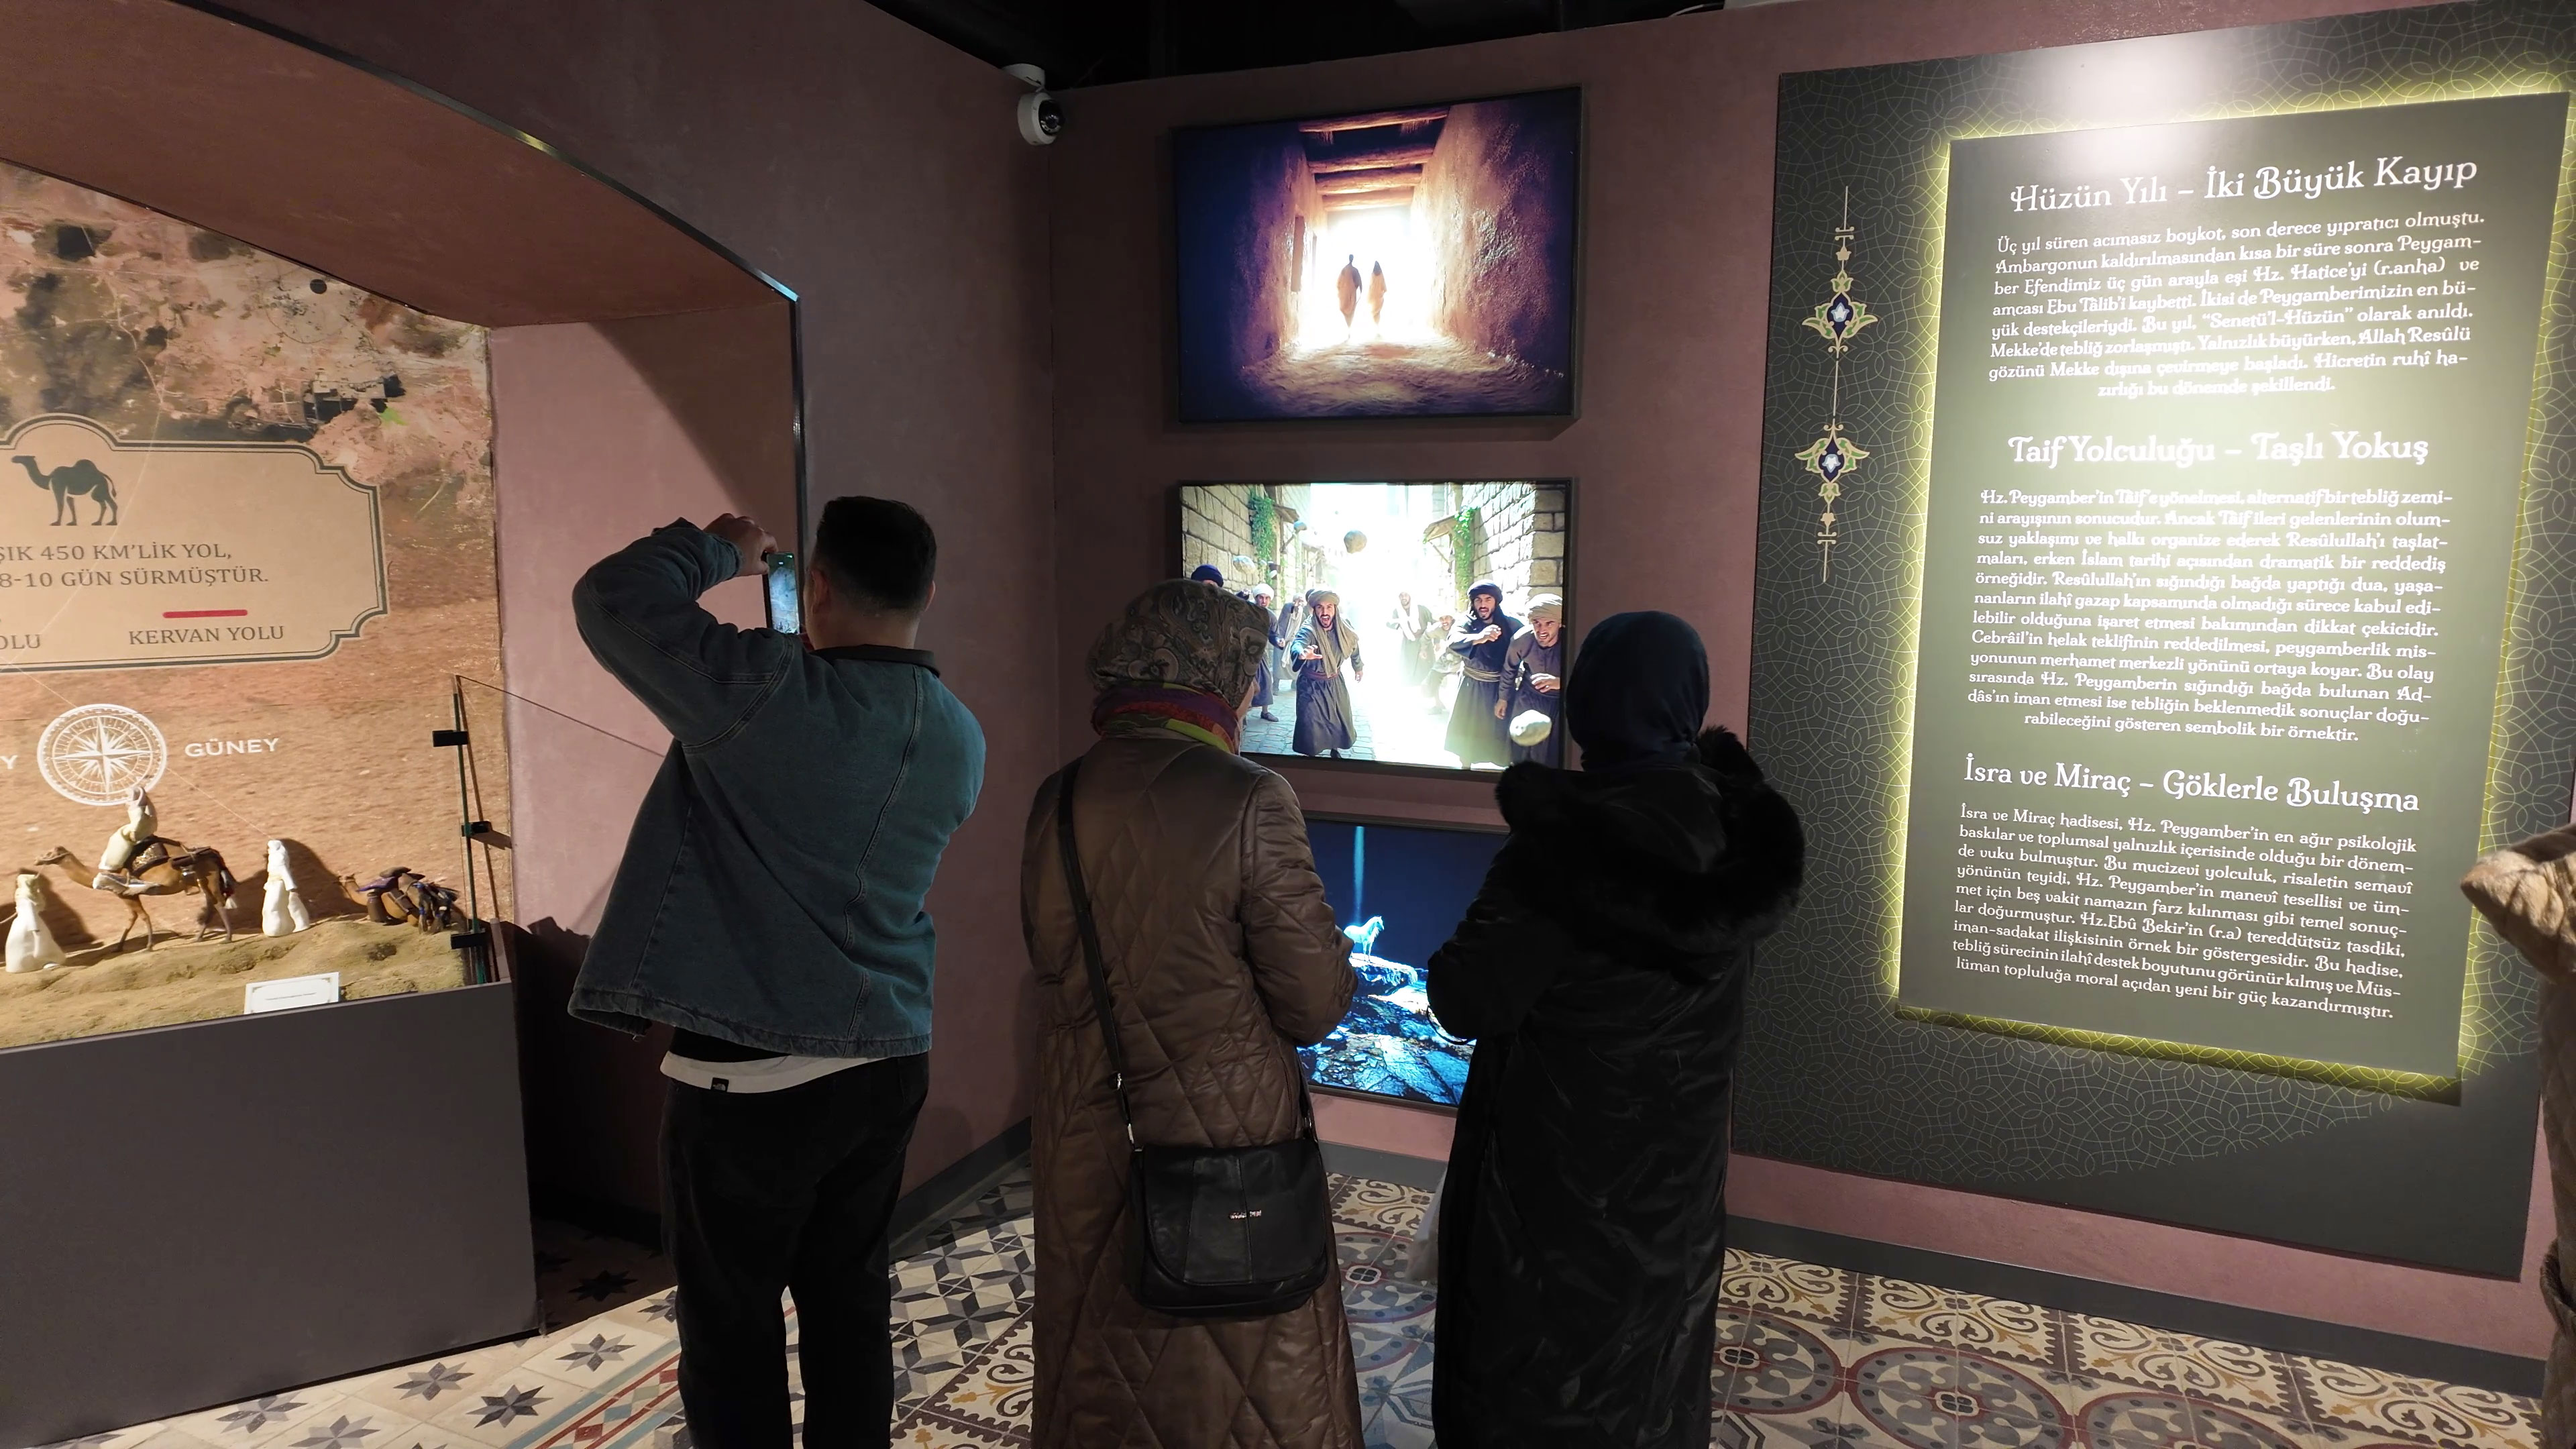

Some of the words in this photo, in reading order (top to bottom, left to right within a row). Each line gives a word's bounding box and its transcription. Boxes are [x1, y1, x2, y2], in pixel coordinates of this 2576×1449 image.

[2010, 184, 2112, 212] Hüzün
[2118, 175, 2167, 205] Yılı
[2203, 164, 2245, 199] İki
[2253, 160, 2365, 199] Büyük
[2373, 155, 2477, 191] Kayıp
[1996, 235, 2017, 256] Üç
[2021, 235, 2041, 255] yıl
[2044, 236, 2088, 250] süren
[2092, 233, 2161, 248] acımasız
[2165, 225, 2226, 246] boykot,
[2231, 227, 2261, 239] son
[2265, 219, 2322, 237] derece
[2326, 217, 2399, 237] yıpratıcı
[2404, 211, 2485, 228] olmuştu.
[1994, 258, 2098, 275] Ambargonun
[2100, 246, 2236, 268] kaldırılmasından
[2238, 244, 2272, 260] kısa
[2274, 242, 2302, 258] bir
[2302, 242, 2341, 257] süre
[2343, 241, 2394, 254] sonra
[1993, 280, 2019, 295] ber
[2023, 276, 2101, 297] Efendimiz
[2106, 276, 2126, 292] üç
[2130, 274, 2163, 292] gün
[2167, 268, 2219, 288] arayla
[2224, 268, 2248, 286] eşi
[2252, 265, 2284, 282] Hz.
[2373, 256, 2445, 276] (r.anha)
[2459, 260, 2479, 271] ve
[1992, 304, 2043, 317] amcası
[2046, 298, 2077, 315] Ebu
[2127, 293, 2197, 313] kaybetti.
[2199, 288, 2235, 307] İkisi
[2237, 288, 2258, 306] de
[2258, 283, 2413, 307] Peygamberimizin
[2416, 285, 2438, 297] en
[2007, 435, 2068, 470] Taif
[2068, 434, 2216, 469] Yolculuğu
[2249, 431, 2324, 467] Taşlı
[2330, 429, 2429, 466] Yokuş
[40, 545, 85, 560] 450
[181, 543, 232, 559] YOL,
[0, 572, 53, 588] 8-10
[61, 569, 113, 586] GÜN
[119, 566, 268, 587] SÜRMÜŞTÜR.
[129, 628, 219, 645] KERVAN
[227, 625, 284, 641] YOLU
[1972, 609, 2016, 624] lebilir
[2020, 610, 2092, 629] olduğuna
[2096, 614, 2141, 631] işaret
[2144, 616, 2196, 630] etmesi
[2200, 615, 2298, 633] bakımından
[2303, 618, 2357, 635] dikkat
[2361, 619, 2438, 638] çekicidir.
[2047, 631, 2088, 647] helak
[2091, 633, 2159, 651] teklifinin
[2163, 635, 2270, 654] reddedilmesi,
[2274, 640, 2392, 658] peygamberlik
[1968, 670, 2035, 686] sırasında
[2040, 670, 2069, 686] Hz.
[2074, 672, 2178, 692] Peygamberin
[2183, 678, 2254, 698] sığındığı
[2259, 680, 2312, 699] bağda
[2318, 682, 2390, 700] bulunan
[1970, 653, 2037, 666] yonunun
[2039, 652, 2117, 669] merhamet
[2118, 655, 2184, 670] merkezli
[2187, 658, 2250, 675] yönünü
[2253, 663, 2307, 678] ortaya
[2310, 660, 2362, 680] koyar.
[2365, 662, 2394, 680] Bu
[2396, 663, 2434, 684] olay
[2013, 691, 2051, 706] iman
[2053, 695, 2102, 708] etmesi
[2105, 696, 2127, 709] ise
[2130, 696, 2190, 714] tebliğin
[2192, 698, 2296, 718] beklenmedik
[2298, 704, 2373, 723] sonuçlar
[2023, 710, 2111, 731] rabileceğini
[2114, 716, 2182, 733] gösteren
[2184, 719, 2257, 736] sembolik
[2259, 721, 2286, 737] bir
[2287, 724, 2359, 742] örnektir.
[184, 738, 279, 757] GÜNEY
[1963, 752, 2012, 784] İsra
[2019, 769, 2047, 786] ve
[2053, 761, 2131, 798] Miraç
[2162, 769, 2279, 802] Göklerle
[2286, 776, 2420, 814] Buluşma
[1958, 823, 2016, 841] baskılar
[2017, 833, 2034, 843] ve
[2037, 831, 2109, 849] toplumsal
[2112, 837, 2178, 854] yalnızlık
[2180, 842, 2255, 861] içerisinde
[2258, 847, 2316, 868] olduğu
[2319, 851, 2345, 867] bir
[1960, 802, 1988, 820] İsra
[1992, 811, 2008, 821] ve
[2012, 808, 2055, 828] Miraç
[2059, 812, 2123, 831] hadisesi,
[2127, 816, 2156, 833] Hz.
[2273, 833, 2294, 843] en
[2298, 832, 2333, 849] ağır
[2336, 834, 2417, 855] psikolojik
[1957, 843, 1975, 857] de
[1979, 845, 2014, 860] vuku
[2018, 847, 2098, 868] bulmuştur.
[2103, 854, 2127, 871] Bu
[2132, 861, 2200, 876] mucizevi
[2204, 865, 2277, 884] yolculuk,
[2282, 871, 2349, 889] risaletin
[2353, 880, 2413, 894] semavî
[1956, 864, 2021, 880] yönünün
[2027, 870, 2071, 885] teyidi,
[2075, 871, 2103, 888] Hz.
[2219, 890, 2278, 903] manevî
[2283, 893, 2343, 909] tesellisi
[2348, 901, 2367, 911] ve
[1955, 955, 2000, 973] lüman
[2003, 963, 2072, 983] topluluğa
[2075, 973, 2118, 987] moral
[2121, 977, 2171, 993] açıdan
[2174, 985, 2208, 998] yeni
[2211, 984, 2235, 1000] bir
[2237, 990, 2267, 1007] güç
[2270, 991, 2393, 1019] kazandırmıştır.
